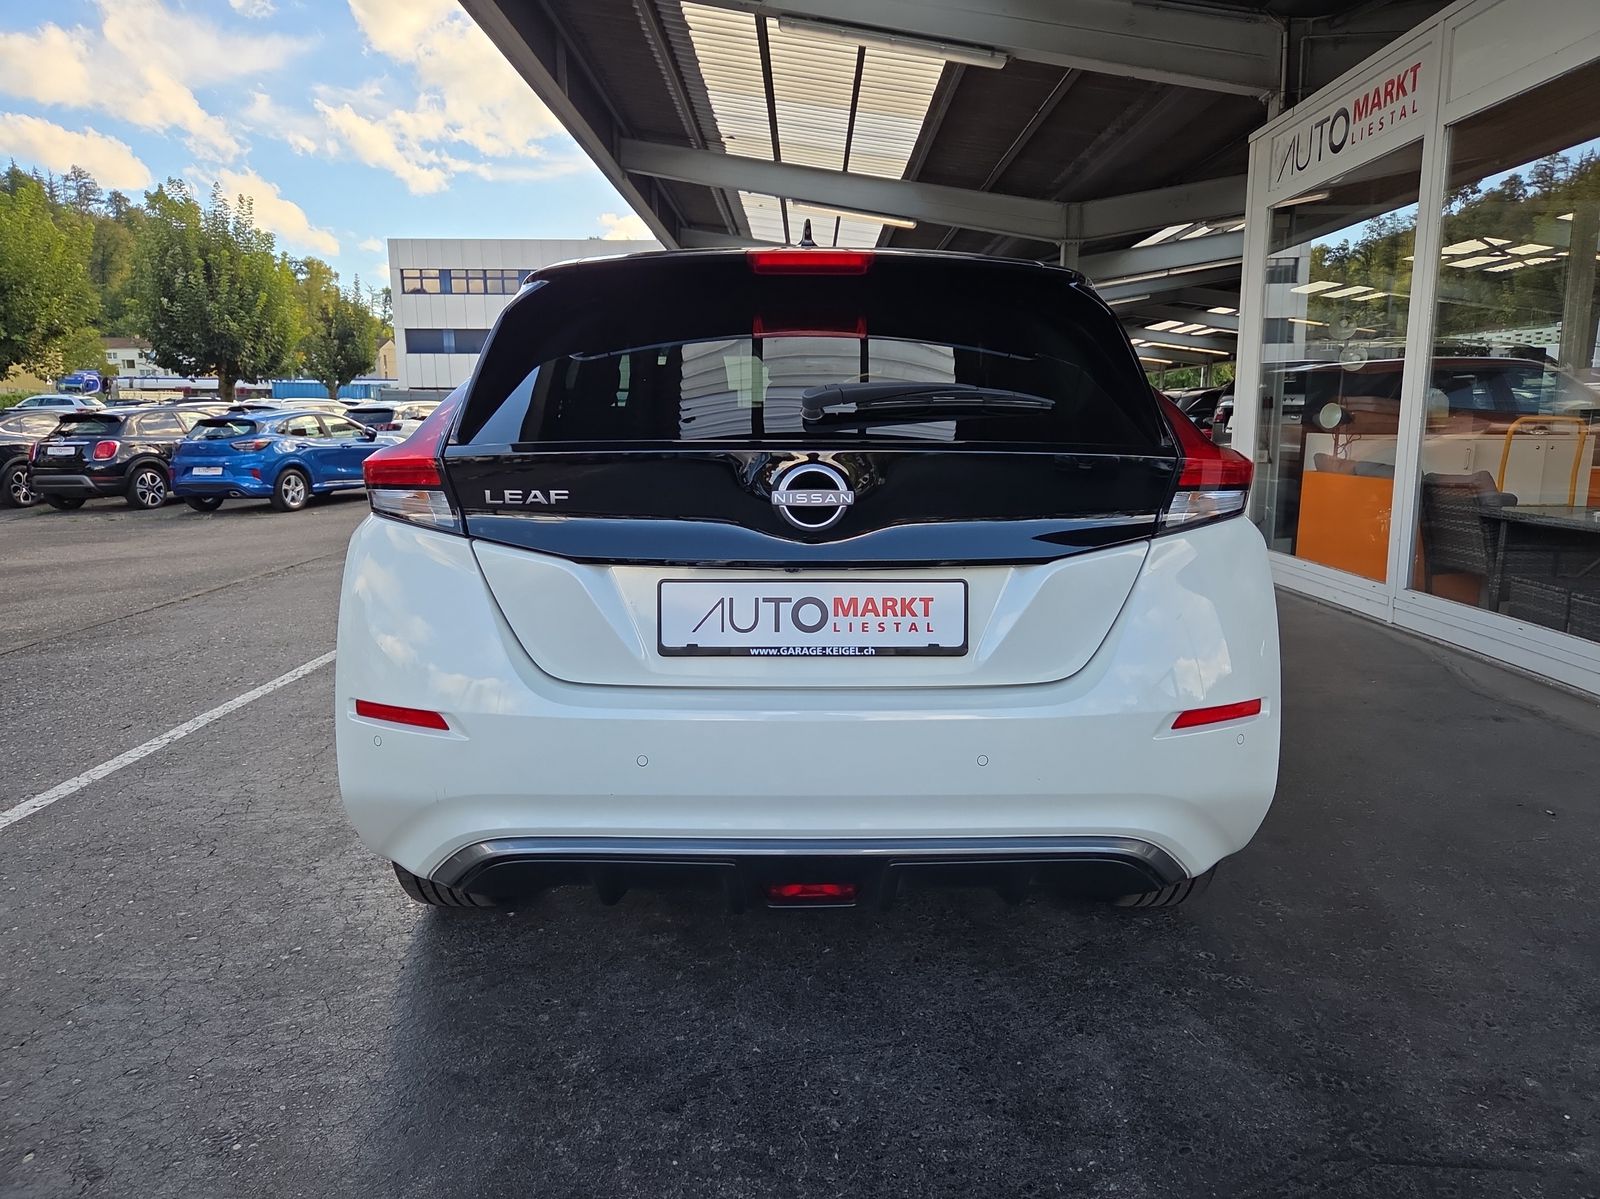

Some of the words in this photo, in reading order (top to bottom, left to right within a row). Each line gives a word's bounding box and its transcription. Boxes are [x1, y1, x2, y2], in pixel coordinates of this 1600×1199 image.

[1277, 107, 1350, 183] AUTO
[1352, 63, 1421, 124] MARKT
[1351, 99, 1418, 145] LIESTAL
[484, 489, 570, 505] LEAF
[772, 490, 854, 505] NISSAN
[692, 597, 829, 634] AUTO
[833, 597, 934, 618] MARKT
[833, 622, 934, 633] LIESTAL
[750, 646, 876, 656] www.GARAGE-KEIGEL.ch
